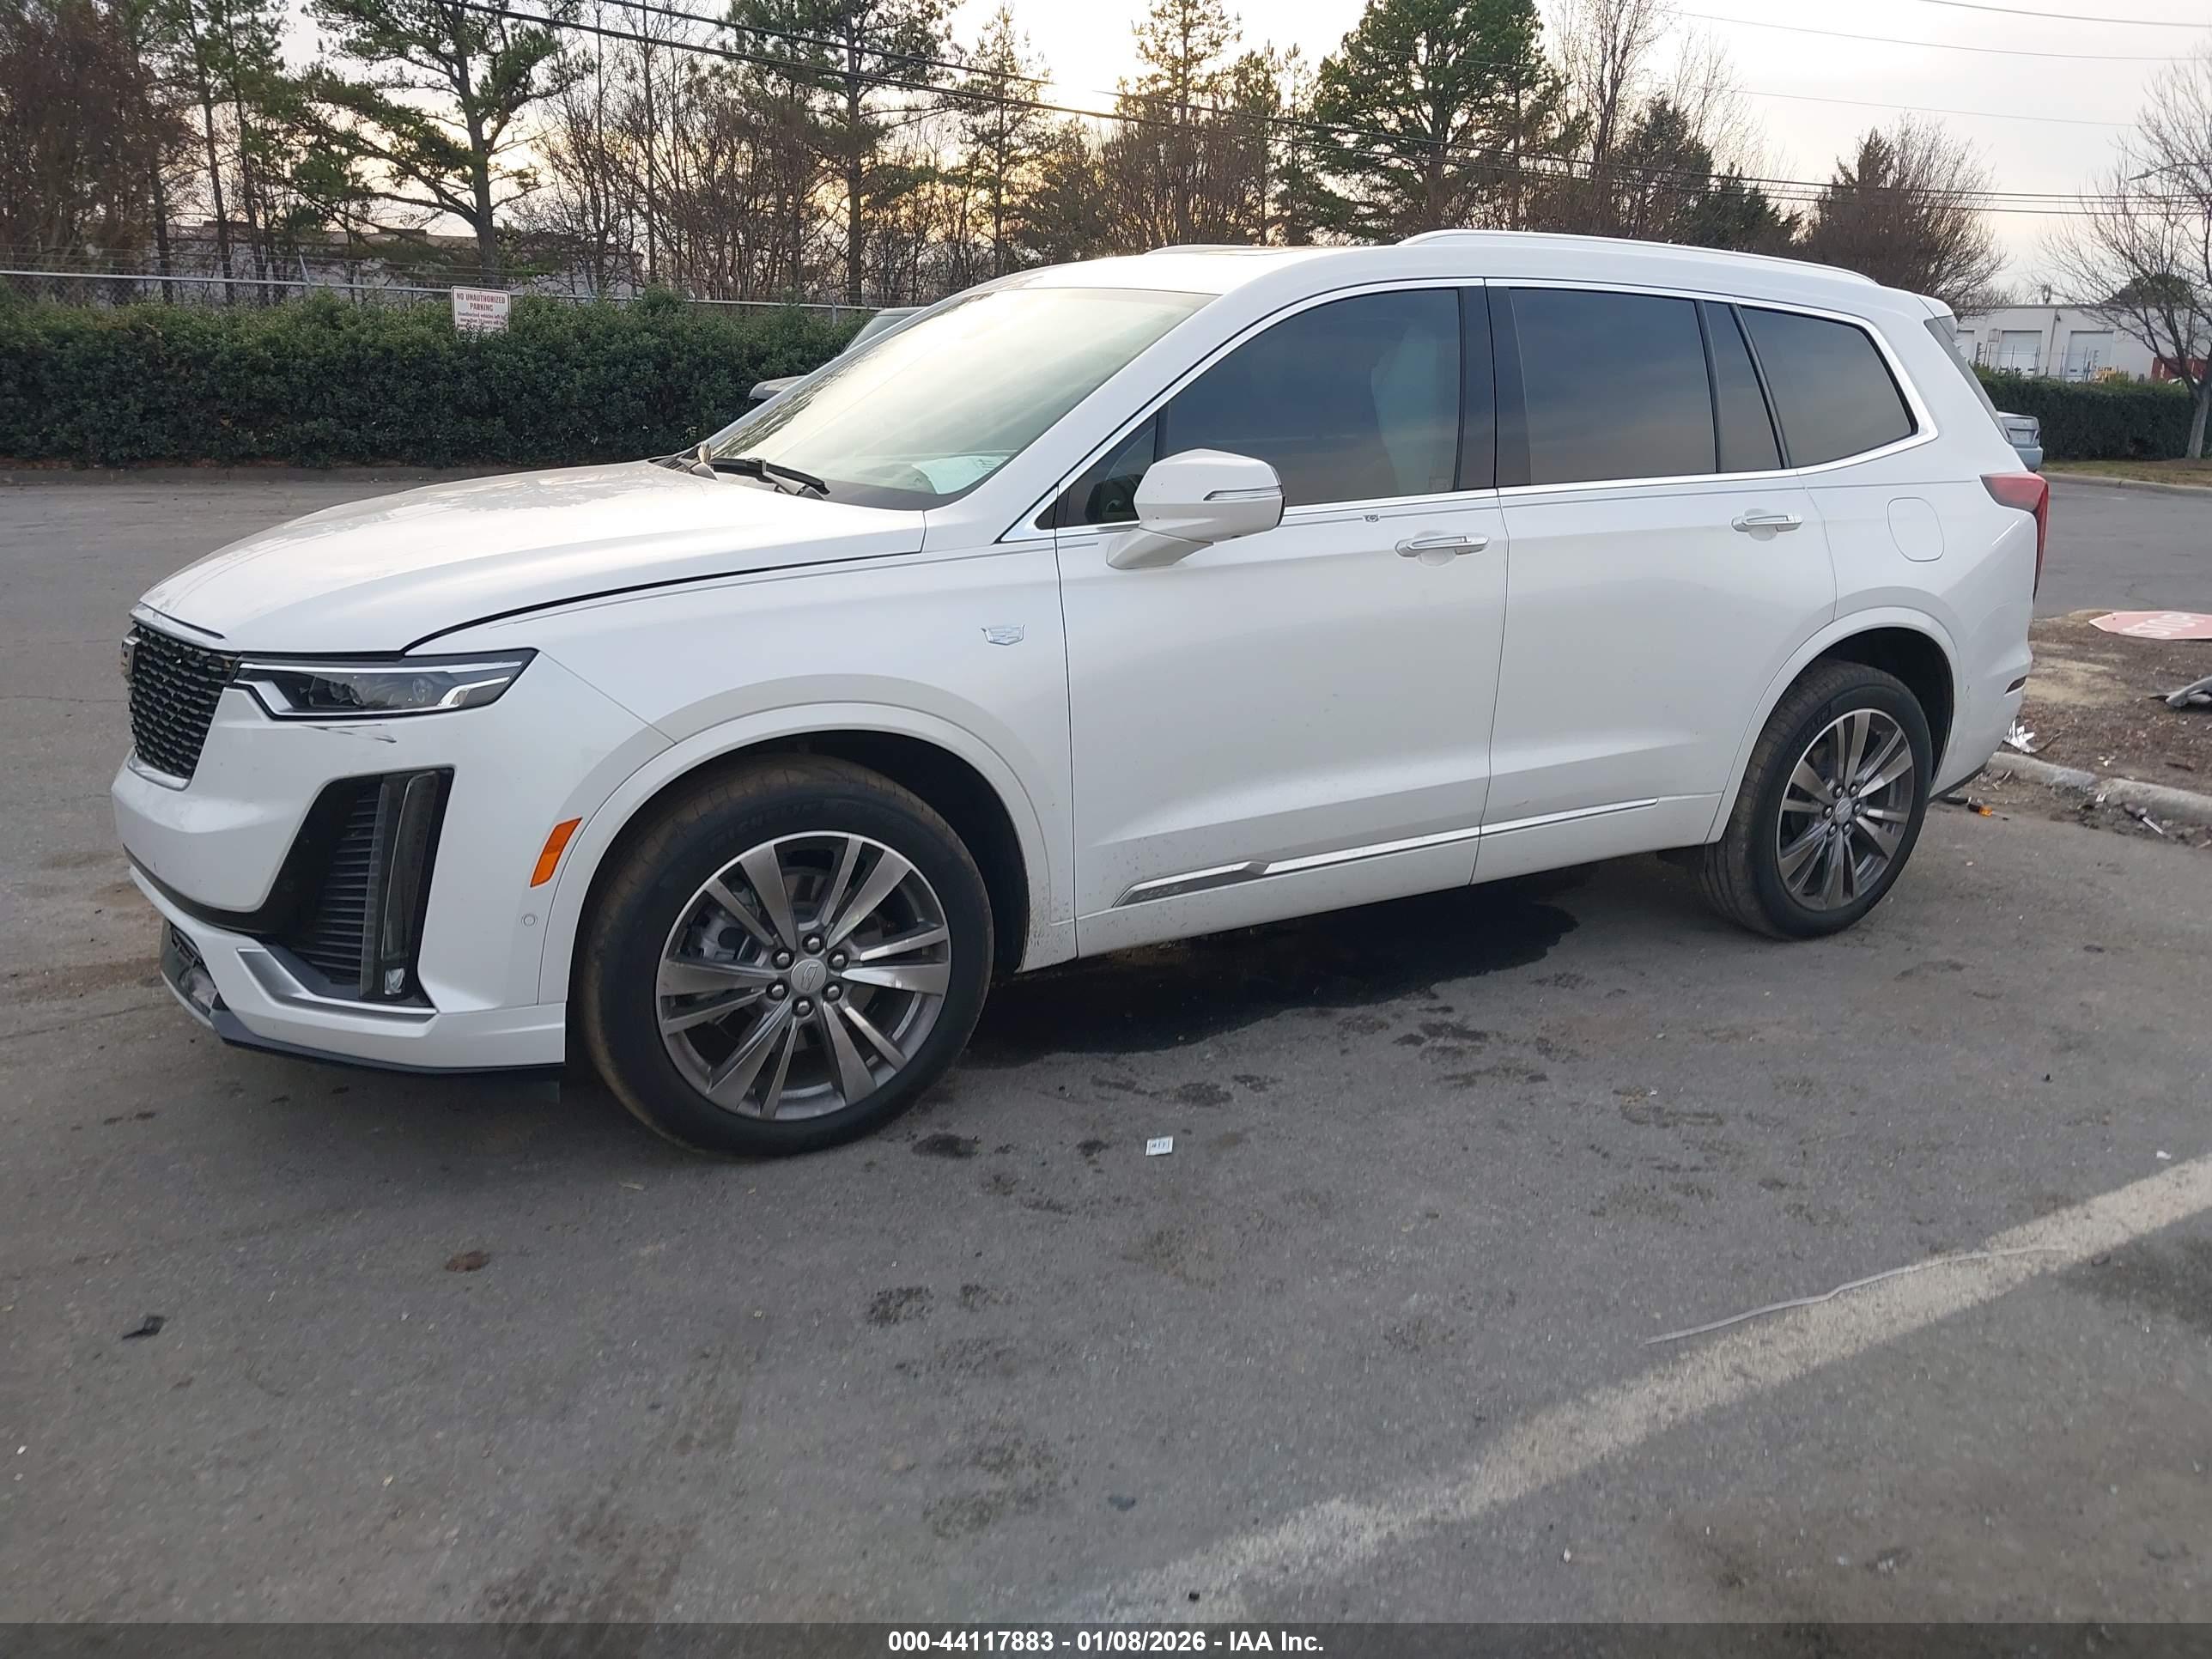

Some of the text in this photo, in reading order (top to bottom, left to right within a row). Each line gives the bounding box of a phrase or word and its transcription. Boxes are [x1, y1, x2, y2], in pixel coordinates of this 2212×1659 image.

[465, 293, 506, 304] UNAUTHORIZED
[470, 303, 494, 312] PARKING
[2123, 614, 2206, 637] STOP
